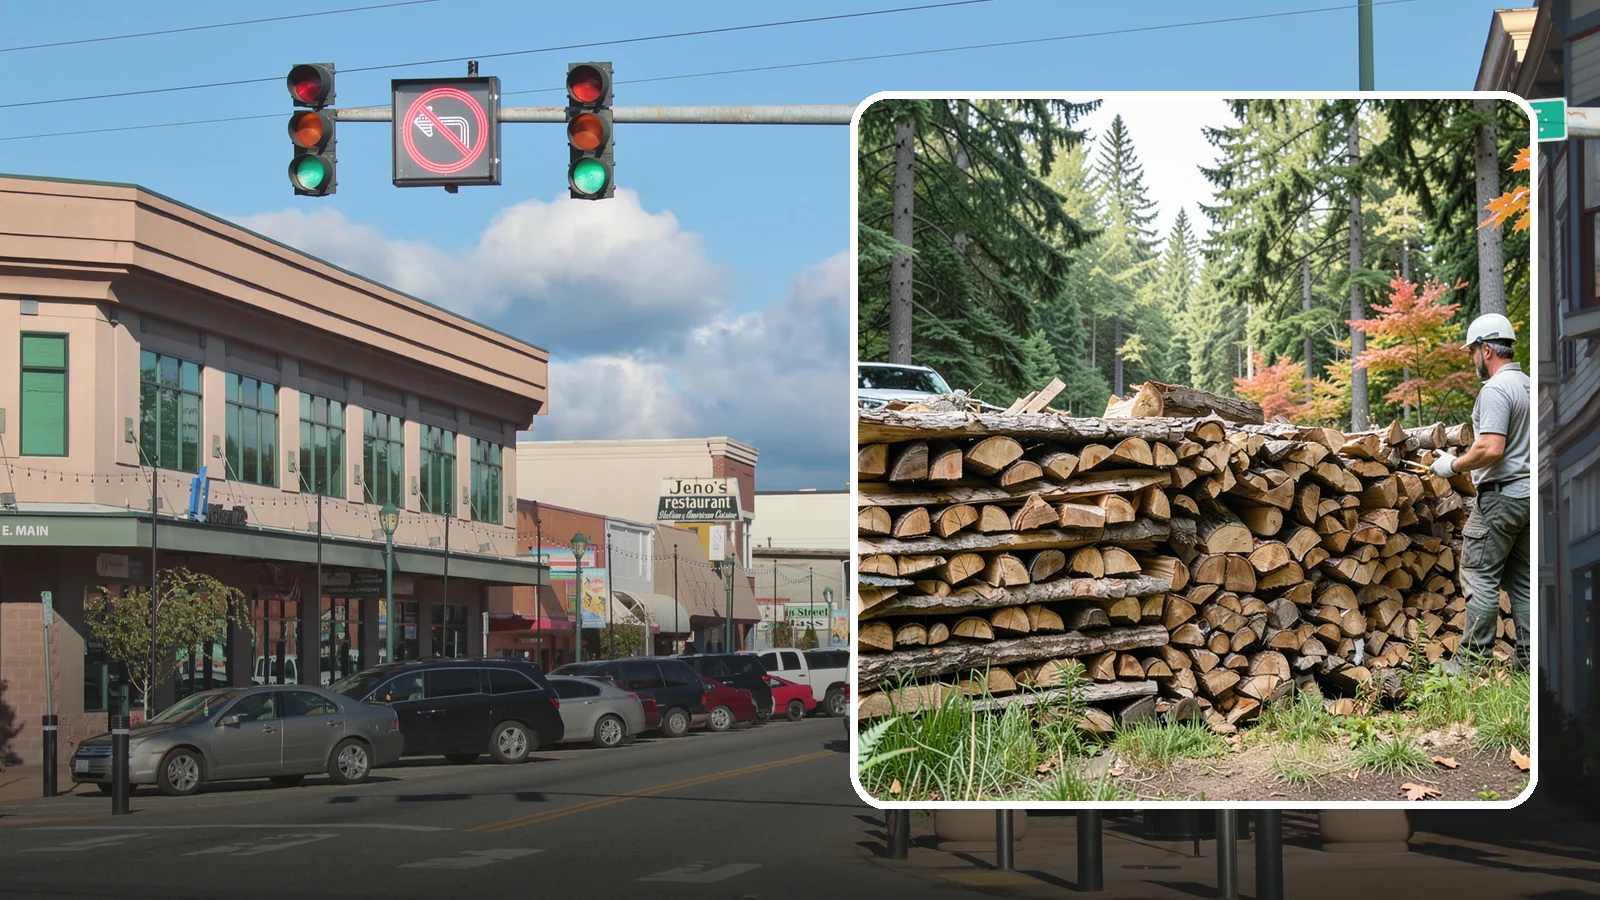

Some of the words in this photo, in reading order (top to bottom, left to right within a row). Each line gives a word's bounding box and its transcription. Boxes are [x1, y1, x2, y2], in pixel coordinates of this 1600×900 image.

[669, 480, 727, 495] Jeno's
[665, 496, 731, 509] restaurant
[659, 510, 681, 519] Italian
[686, 509, 714, 519] American
[715, 509, 737, 519] Cuisine
[2, 525, 13, 536] E.
[15, 525, 49, 536] MAIN
[797, 607, 828, 617] Street
[790, 619, 823, 627] lass
